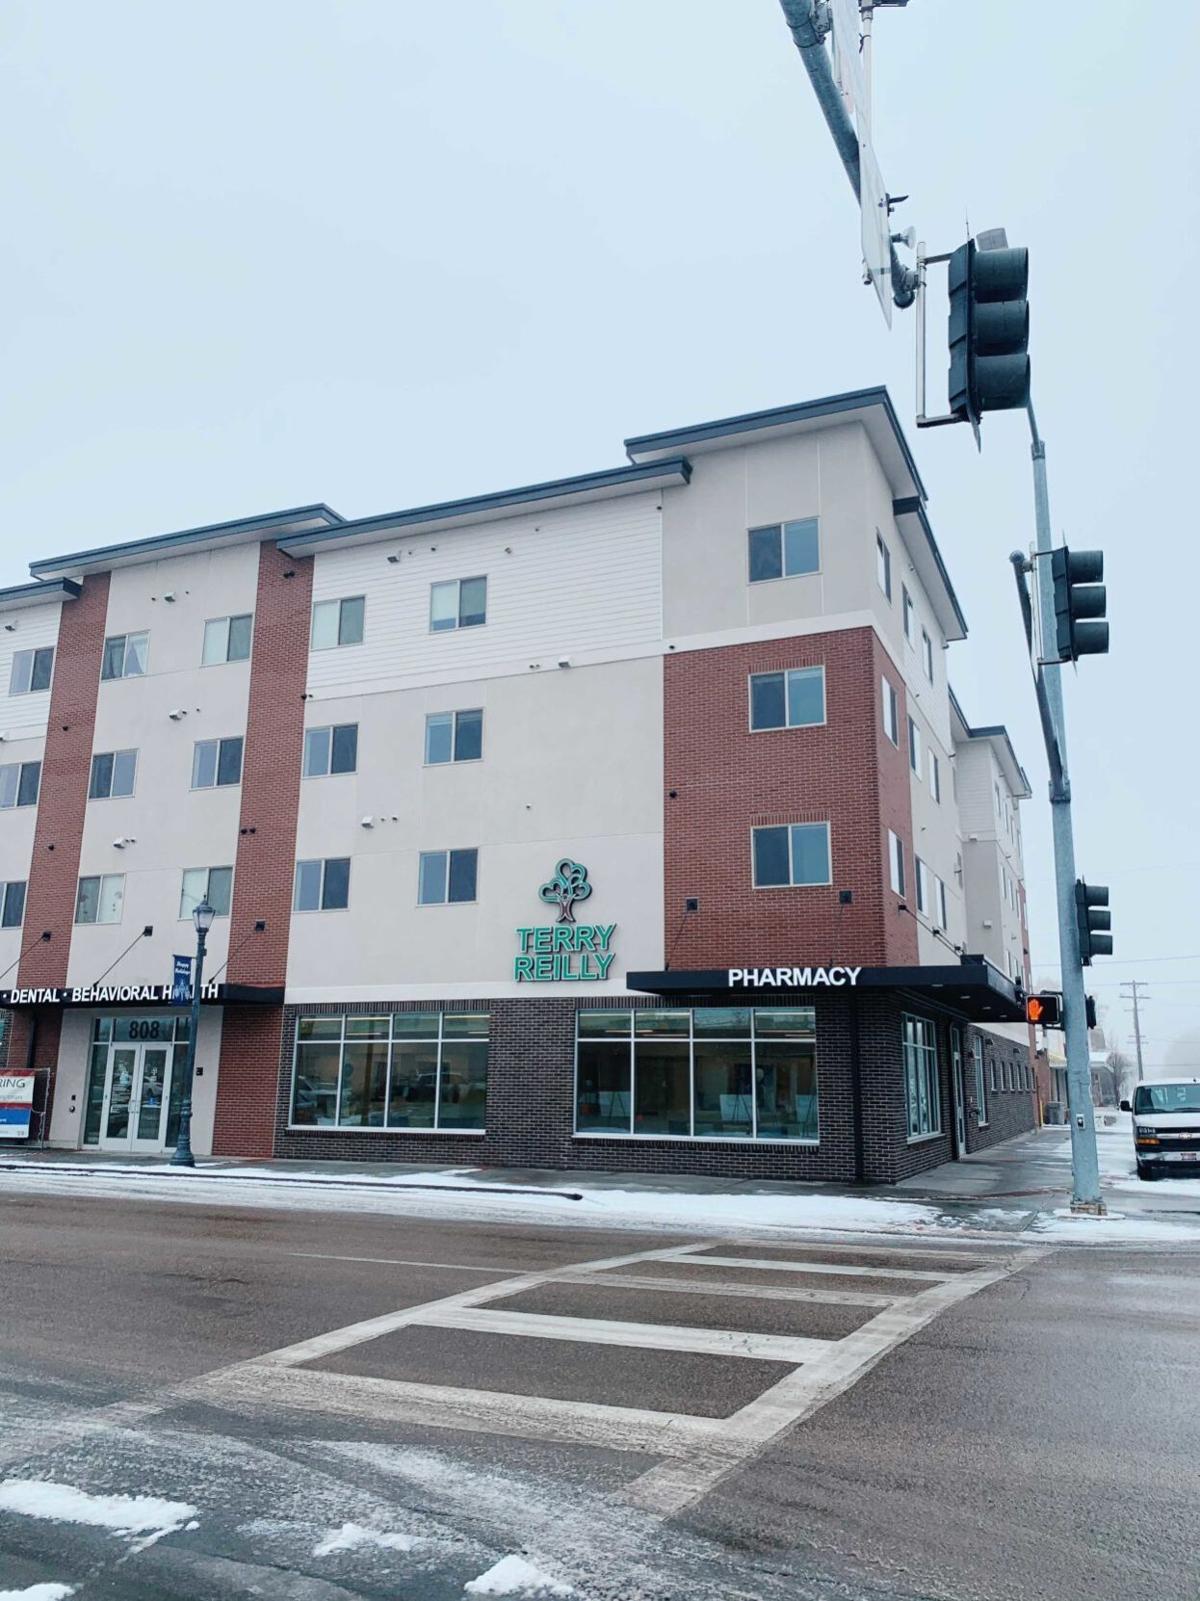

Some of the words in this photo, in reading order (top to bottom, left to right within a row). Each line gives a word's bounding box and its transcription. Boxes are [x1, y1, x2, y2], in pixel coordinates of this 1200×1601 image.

[516, 923, 616, 954] TERRY
[514, 953, 615, 982] REILLY
[727, 967, 863, 987] PHARMACY
[10, 988, 60, 1004] DENTAL
[72, 986, 158, 1002] BEHAVIORAL
[162, 984, 218, 1001] HTH
[129, 1020, 160, 1039] 808
